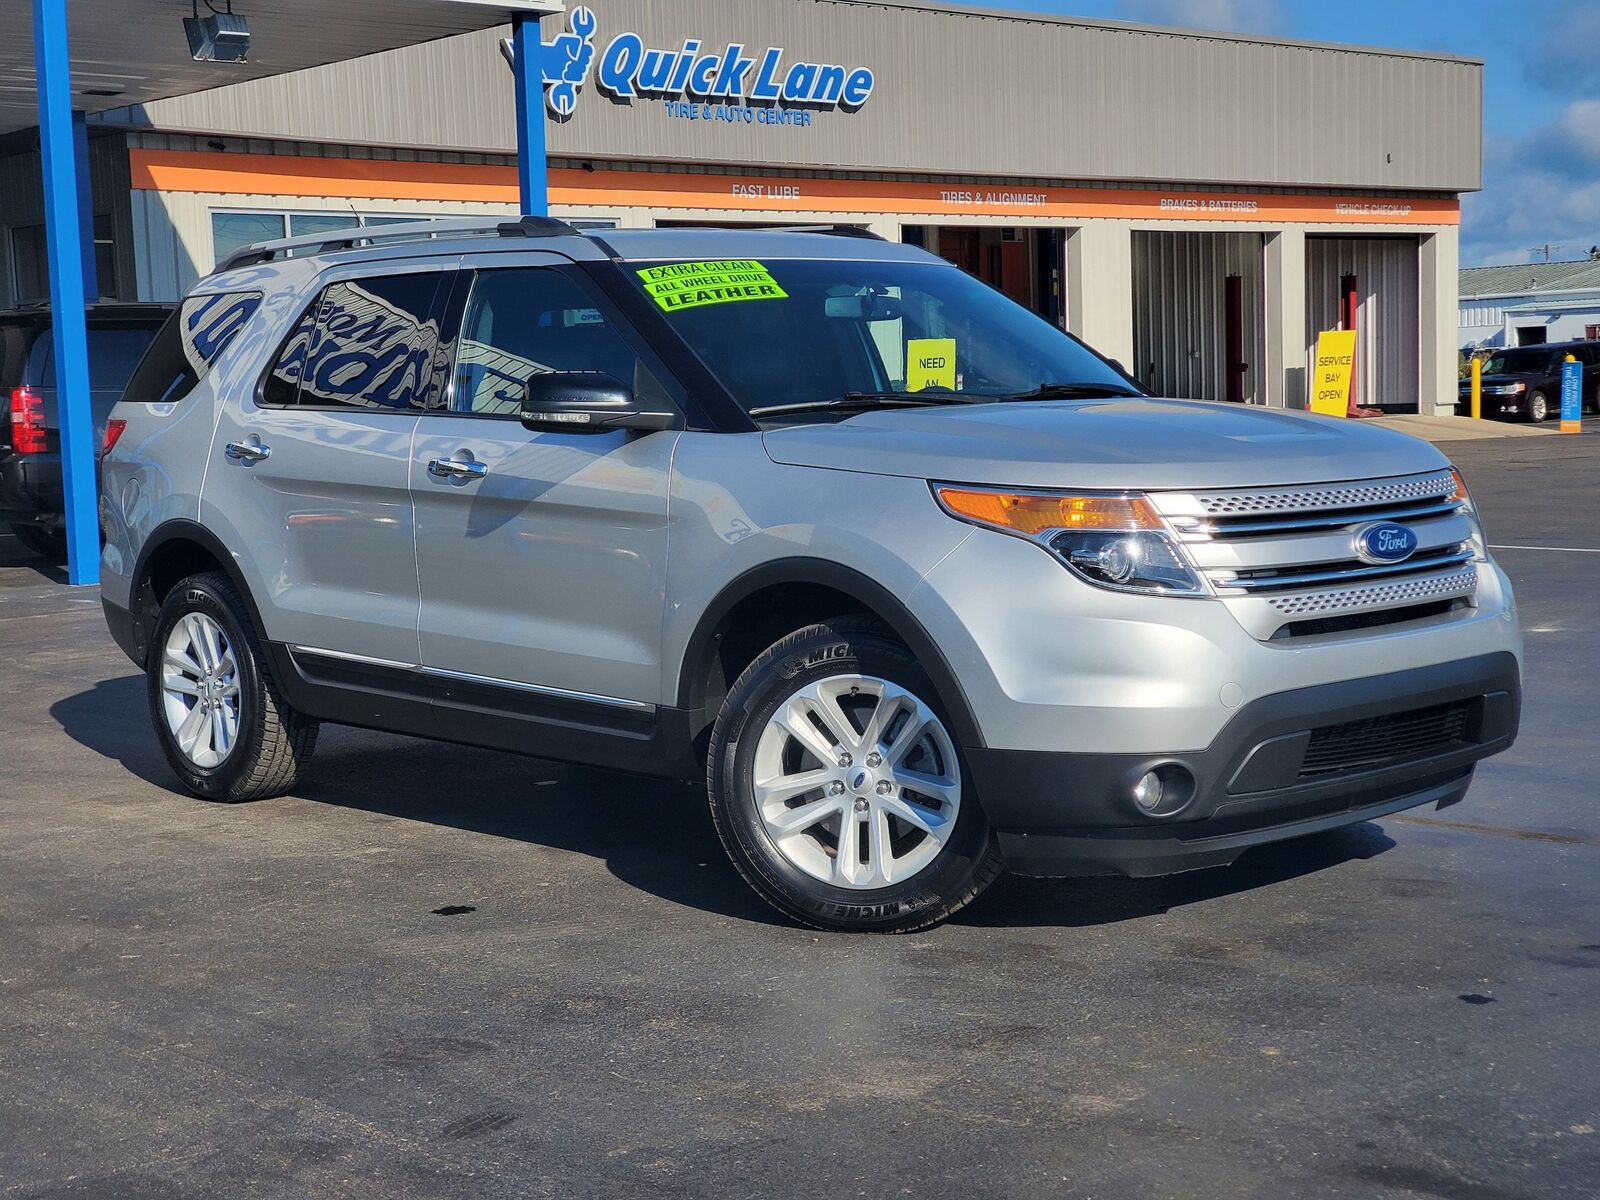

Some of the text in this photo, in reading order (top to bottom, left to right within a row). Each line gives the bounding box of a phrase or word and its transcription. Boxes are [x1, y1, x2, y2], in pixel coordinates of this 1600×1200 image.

[598, 31, 875, 106] Quick Lane
[665, 101, 812, 127] TIRE & AUTO CENTER
[732, 184, 800, 200] FAST LUBE
[940, 191, 1047, 207] TIRES & ALIGNMENT
[1160, 198, 1258, 213] BRAKES & BATTERIES
[1335, 203, 1370, 215] VEHICLE
[649, 260, 754, 280] EXTRA CLEAN
[654, 273, 766, 294] ALL WHEEL DRIVE
[664, 284, 777, 307] LEATHER
[919, 357, 946, 369] NEED
[1318, 355, 1351, 367] SERVICE
[1325, 373, 1341, 383] BAY
[1318, 390, 1343, 400] OPEN!
[1378, 529, 1409, 552] Ford
